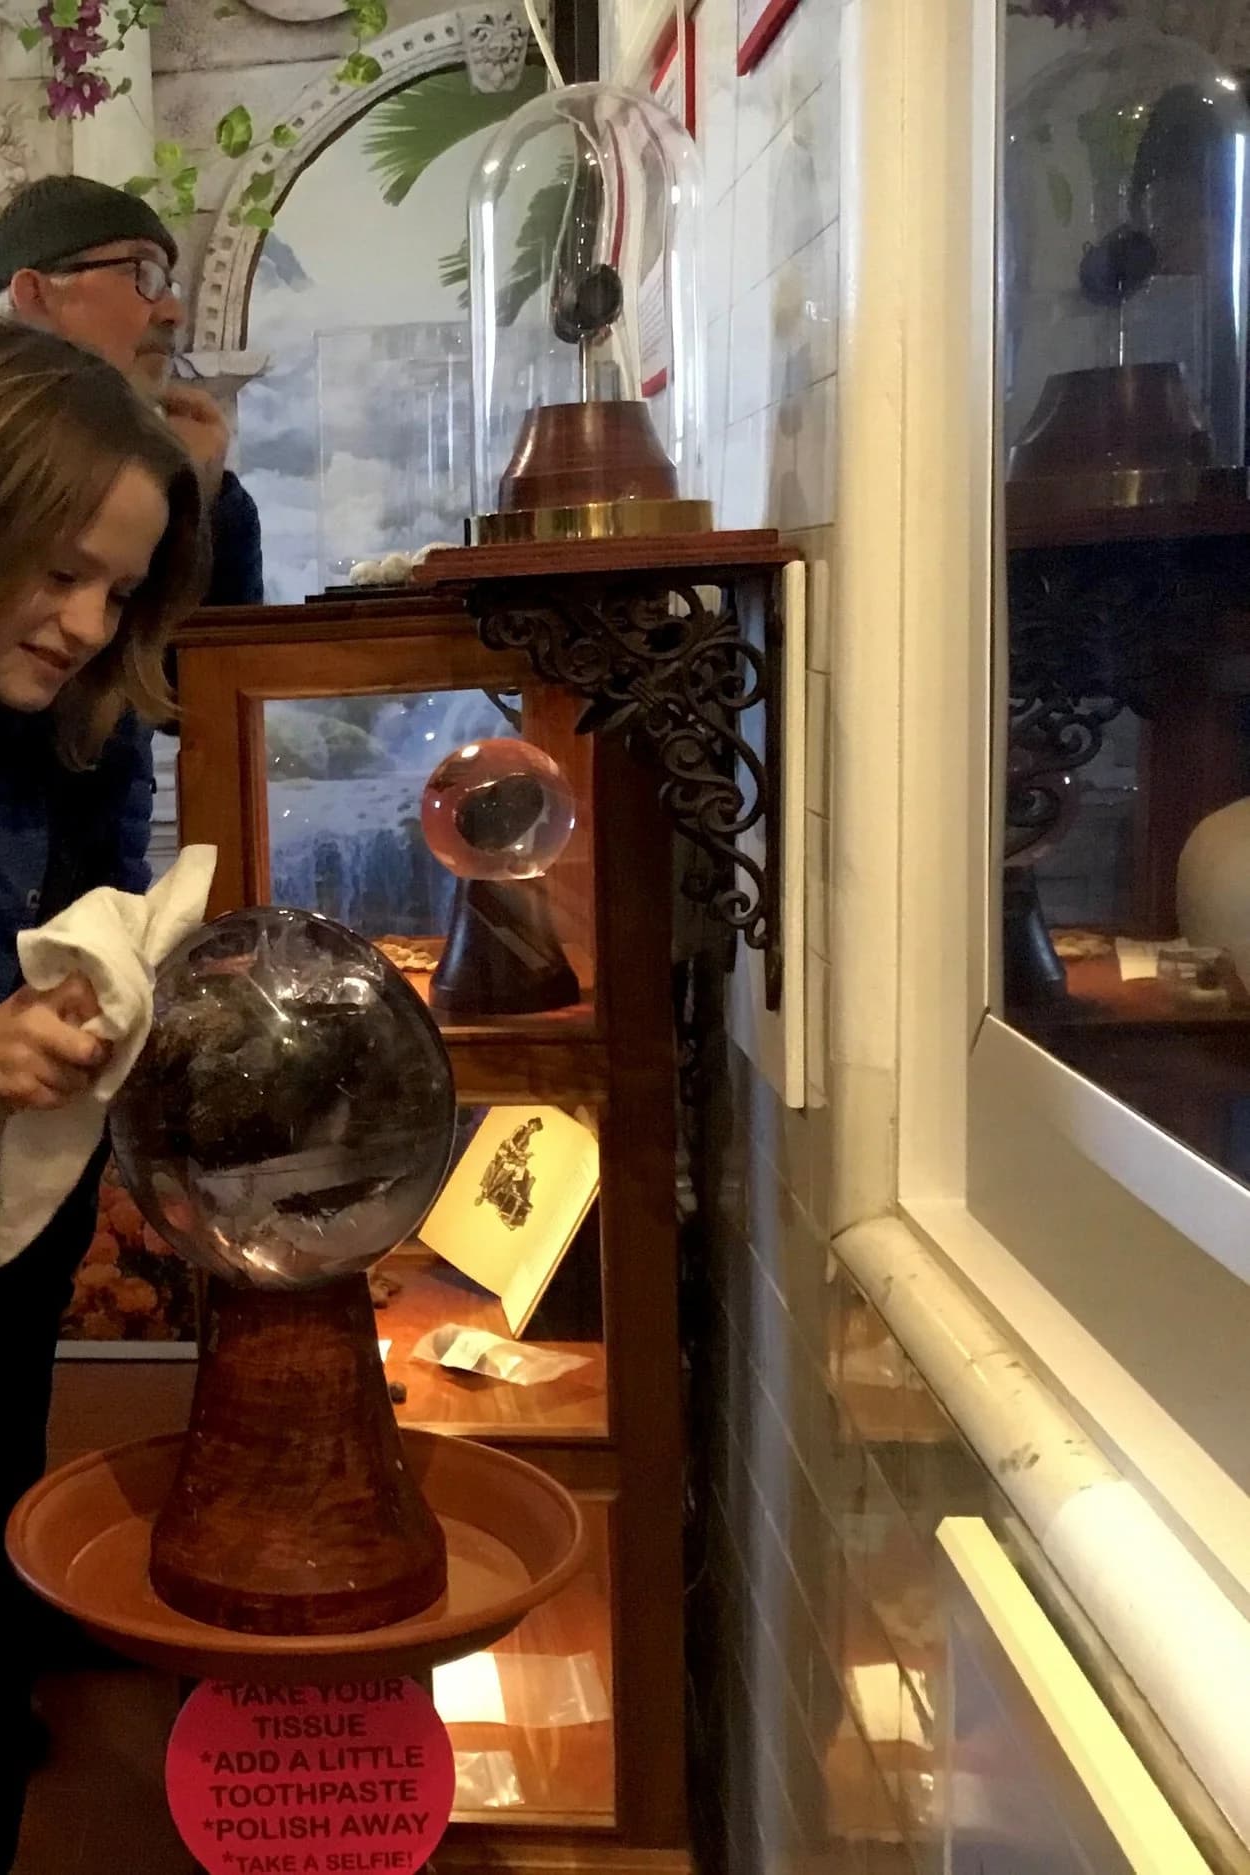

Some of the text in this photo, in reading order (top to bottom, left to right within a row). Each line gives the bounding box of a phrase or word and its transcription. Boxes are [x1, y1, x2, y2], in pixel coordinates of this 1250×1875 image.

[315, 1678, 404, 1704] YOUR
[252, 1714, 367, 1739] TISSUE
[289, 1750, 310, 1772] A
[319, 1745, 425, 1771] LITTLE
[209, 1779, 419, 1808] TOOTHPASTE
[341, 1812, 430, 1837] AWAY
[303, 1853, 320, 1872] A
[326, 1850, 413, 1871] SELFIE!
